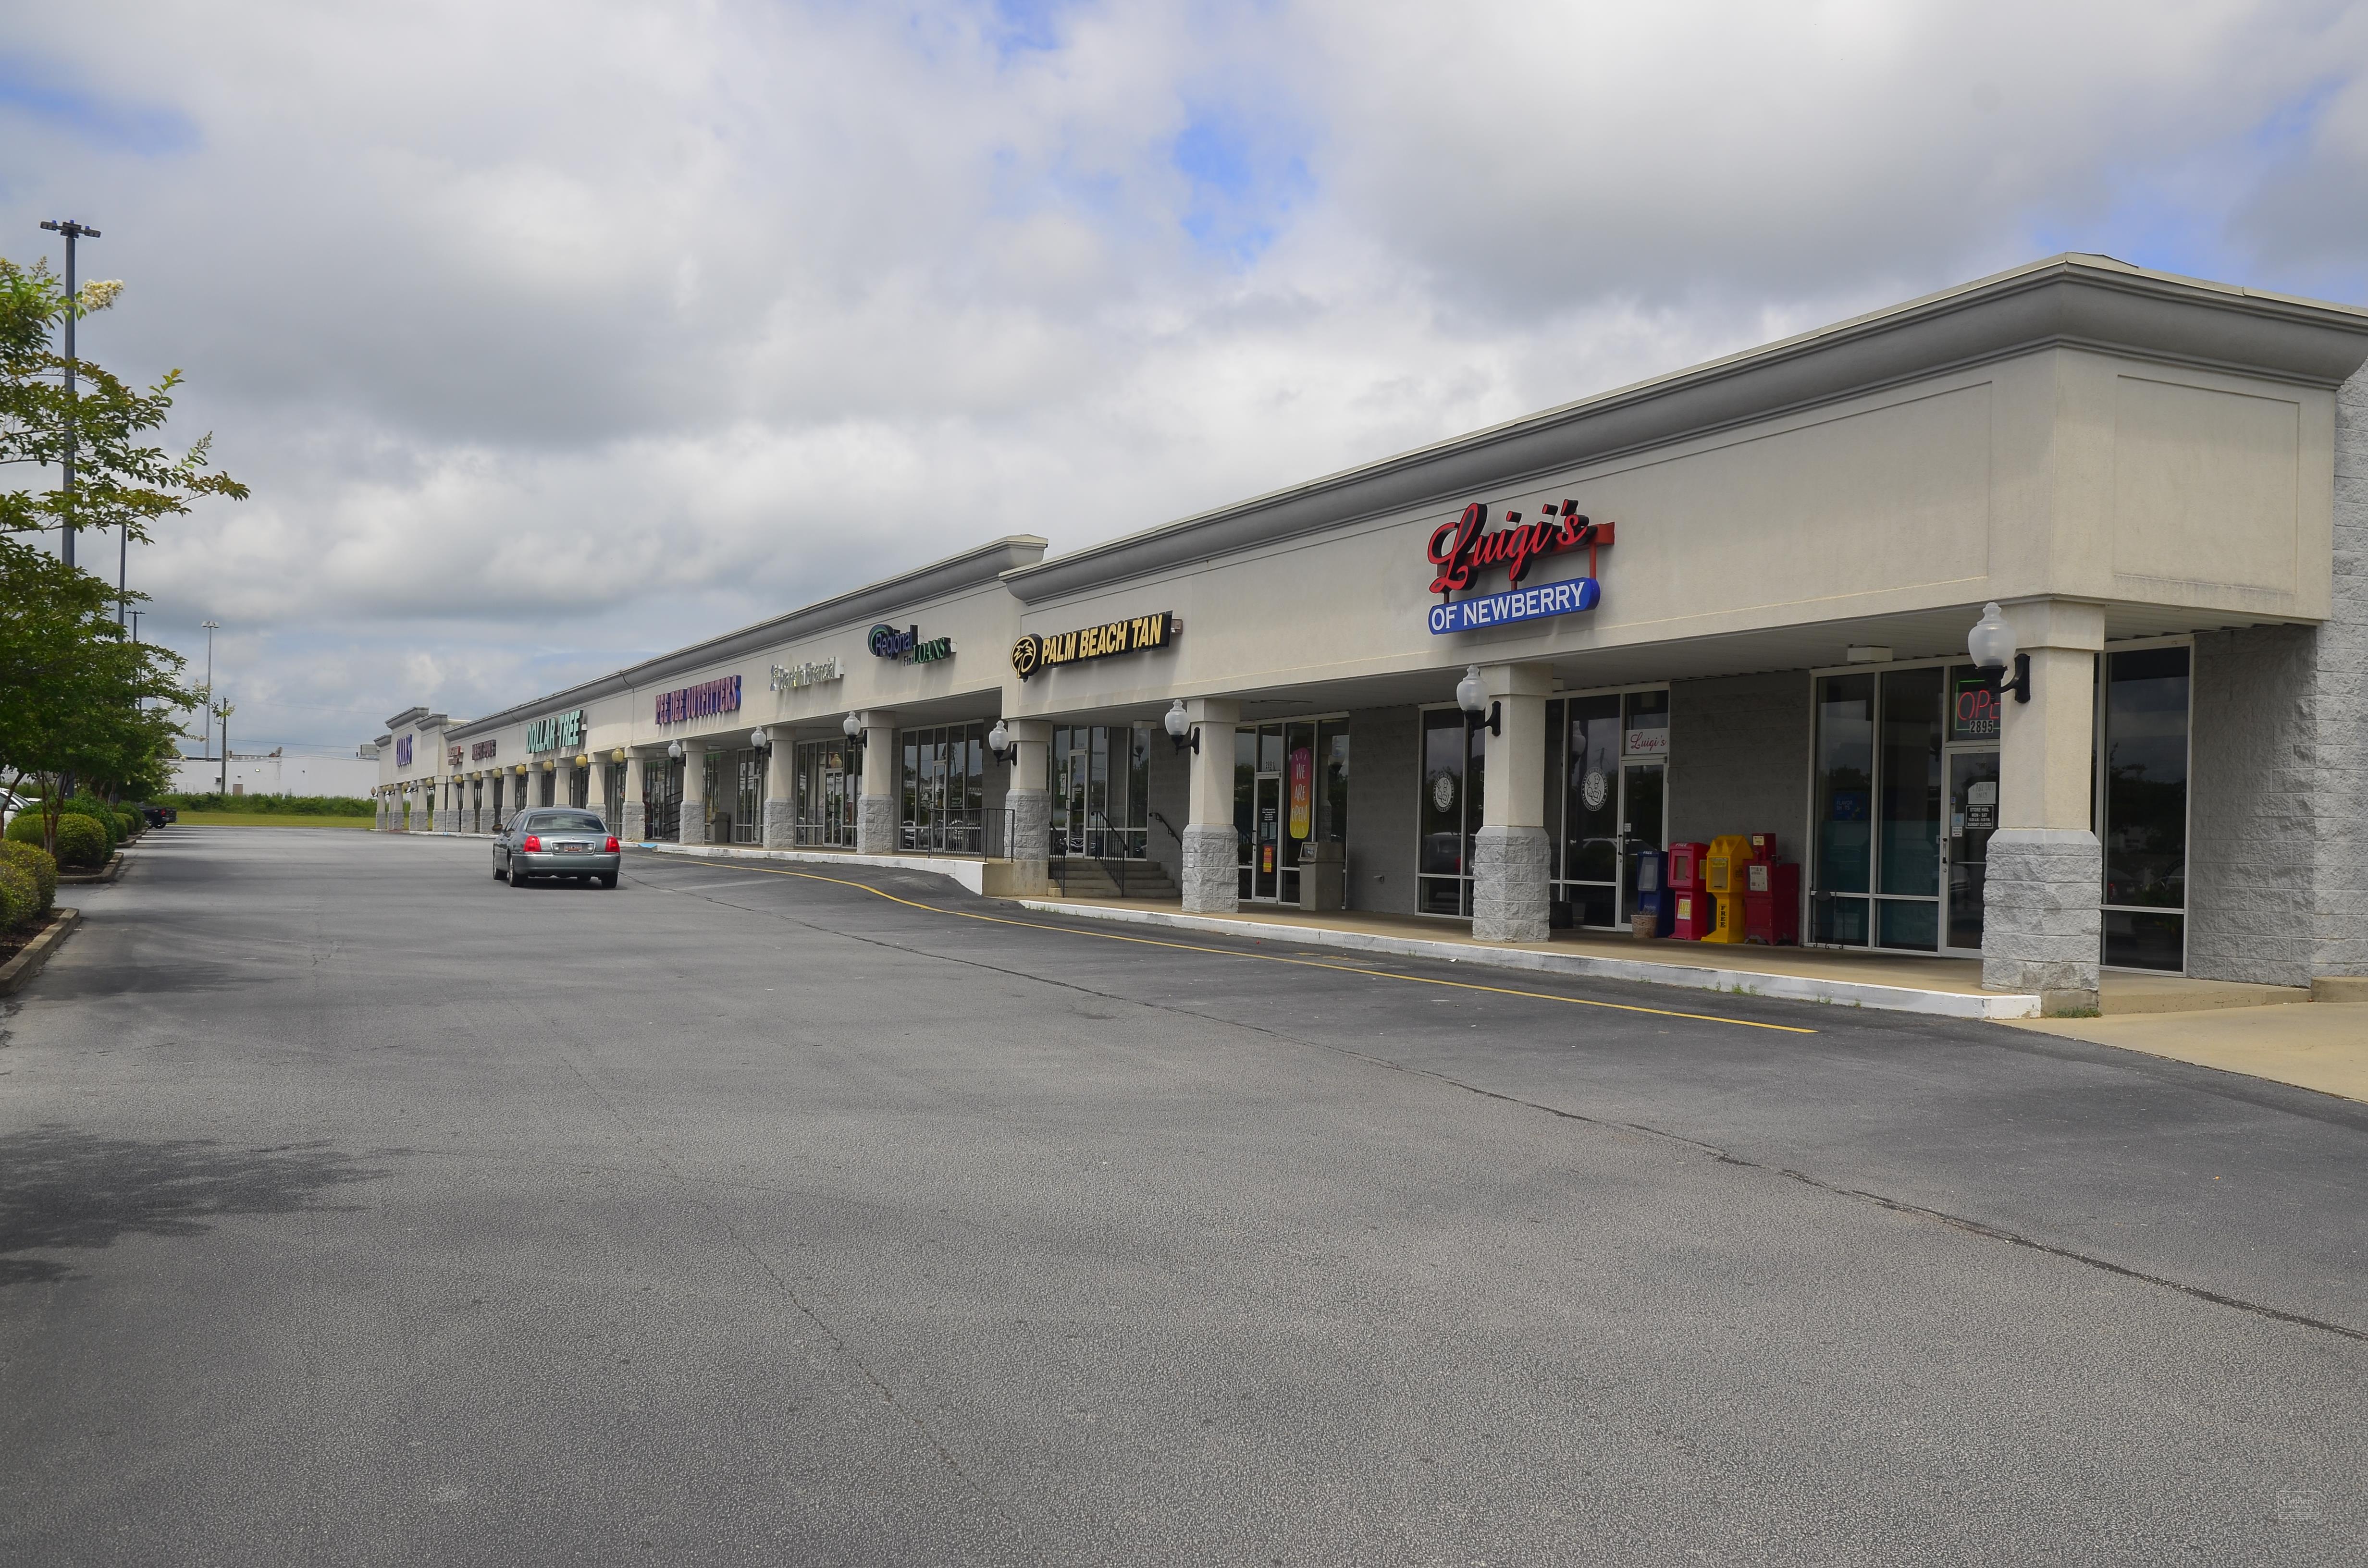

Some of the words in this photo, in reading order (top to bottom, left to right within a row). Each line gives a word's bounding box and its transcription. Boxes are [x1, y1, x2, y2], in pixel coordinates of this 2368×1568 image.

[1427, 499, 1590, 594] Luigi's
[1431, 605, 1457, 631] OF
[1463, 581, 1586, 626] NEWBERRY
[876, 625, 915, 660] Regional
[913, 637, 947, 664] LOANS
[1041, 631, 1076, 665] PALM
[1079, 621, 1128, 658] BEACH
[1132, 614, 1163, 648] TAN
[655, 692, 670, 724] PEE
[670, 689, 686, 722] DEE
[686, 674, 739, 719] OUTFITTERS
[526, 717, 556, 754] DOLLAR
[558, 710, 582, 748] TREE
[1630, 731, 1666, 751] Luigi's
[1970, 721, 1993, 733] 2895
[1296, 763, 1306, 780] WE
[1294, 784, 1306, 802] ARE
[1291, 804, 1307, 823] OPEN!
